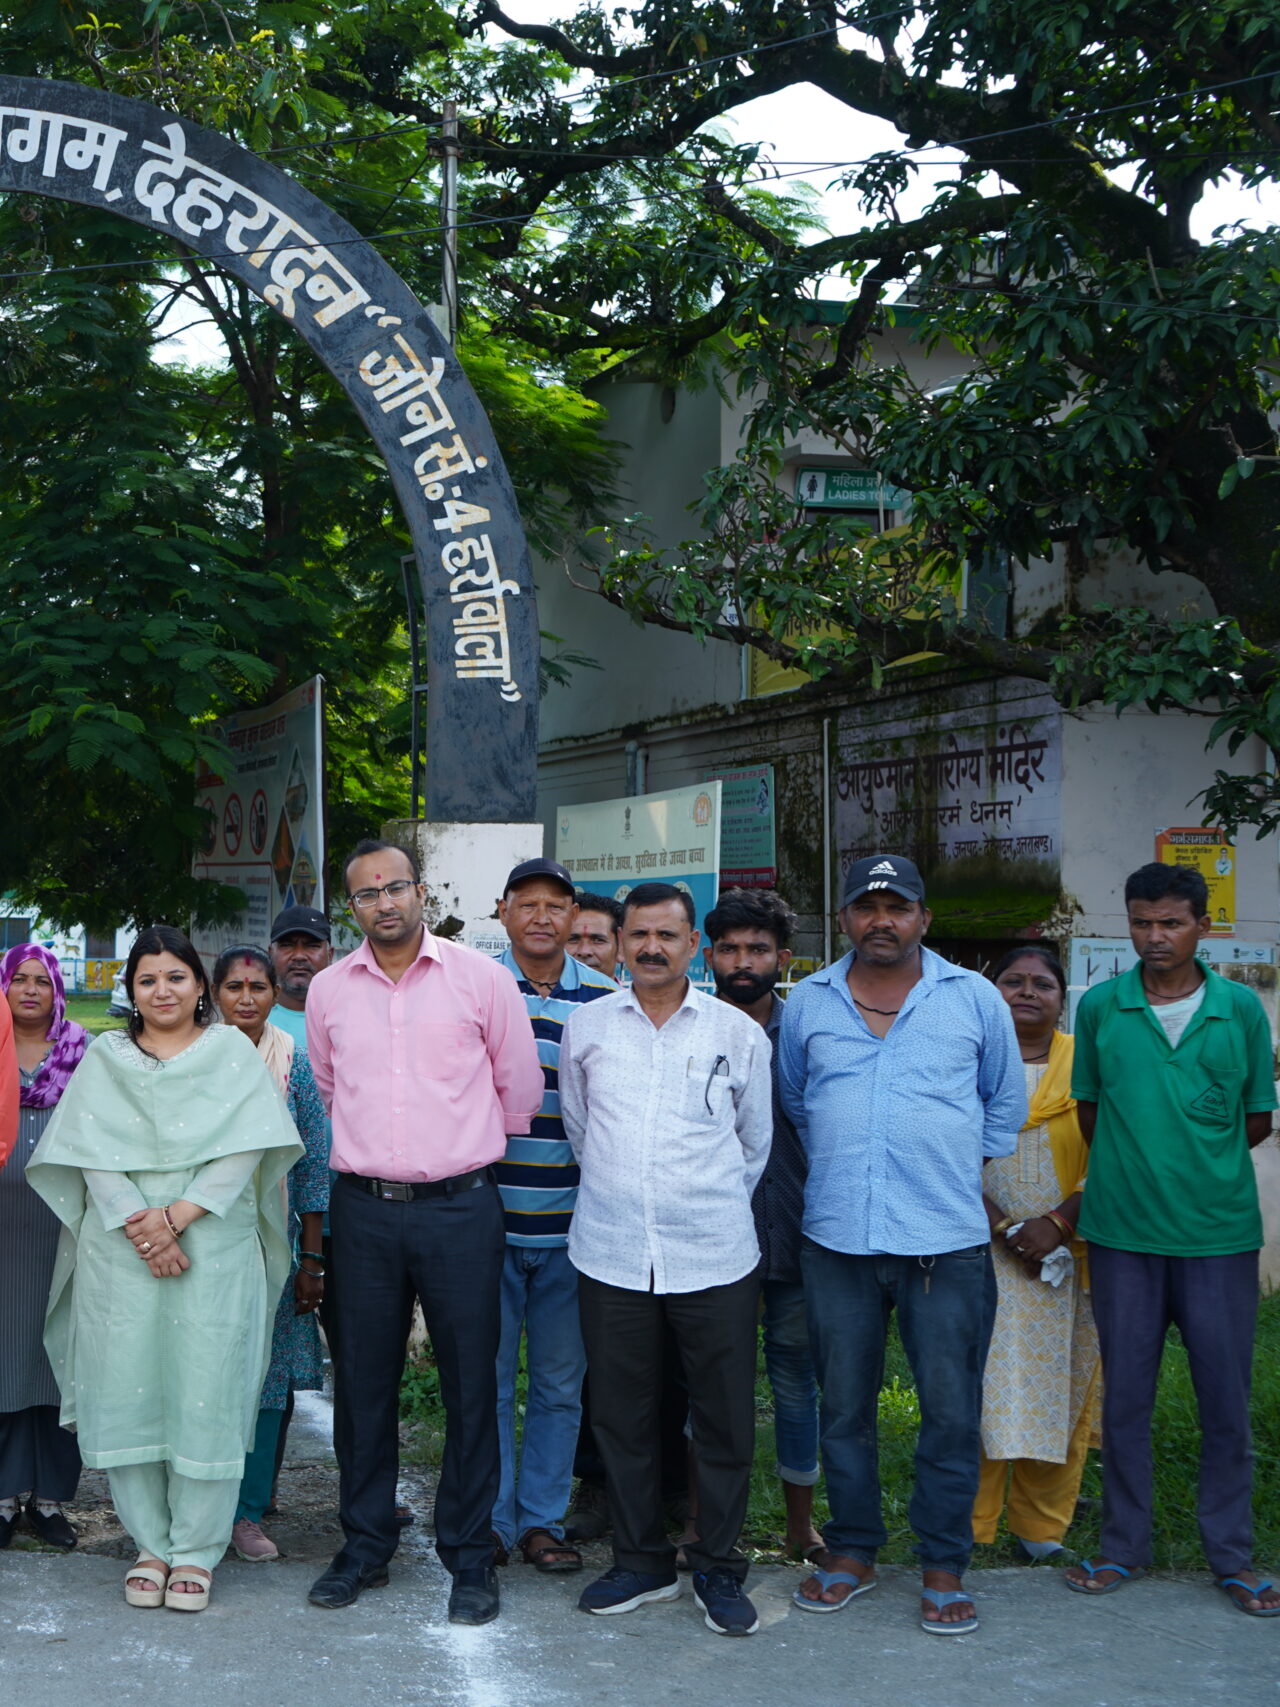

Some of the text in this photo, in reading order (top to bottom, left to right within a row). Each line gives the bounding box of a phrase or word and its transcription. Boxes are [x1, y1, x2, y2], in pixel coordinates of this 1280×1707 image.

[134, 122, 371, 328] देहरादून
[828, 490, 866, 500] LADIES
[837, 724, 1048, 814] आयुष्मान आरोग्य मंदिर
[476, 941, 492, 949] OFFICE
